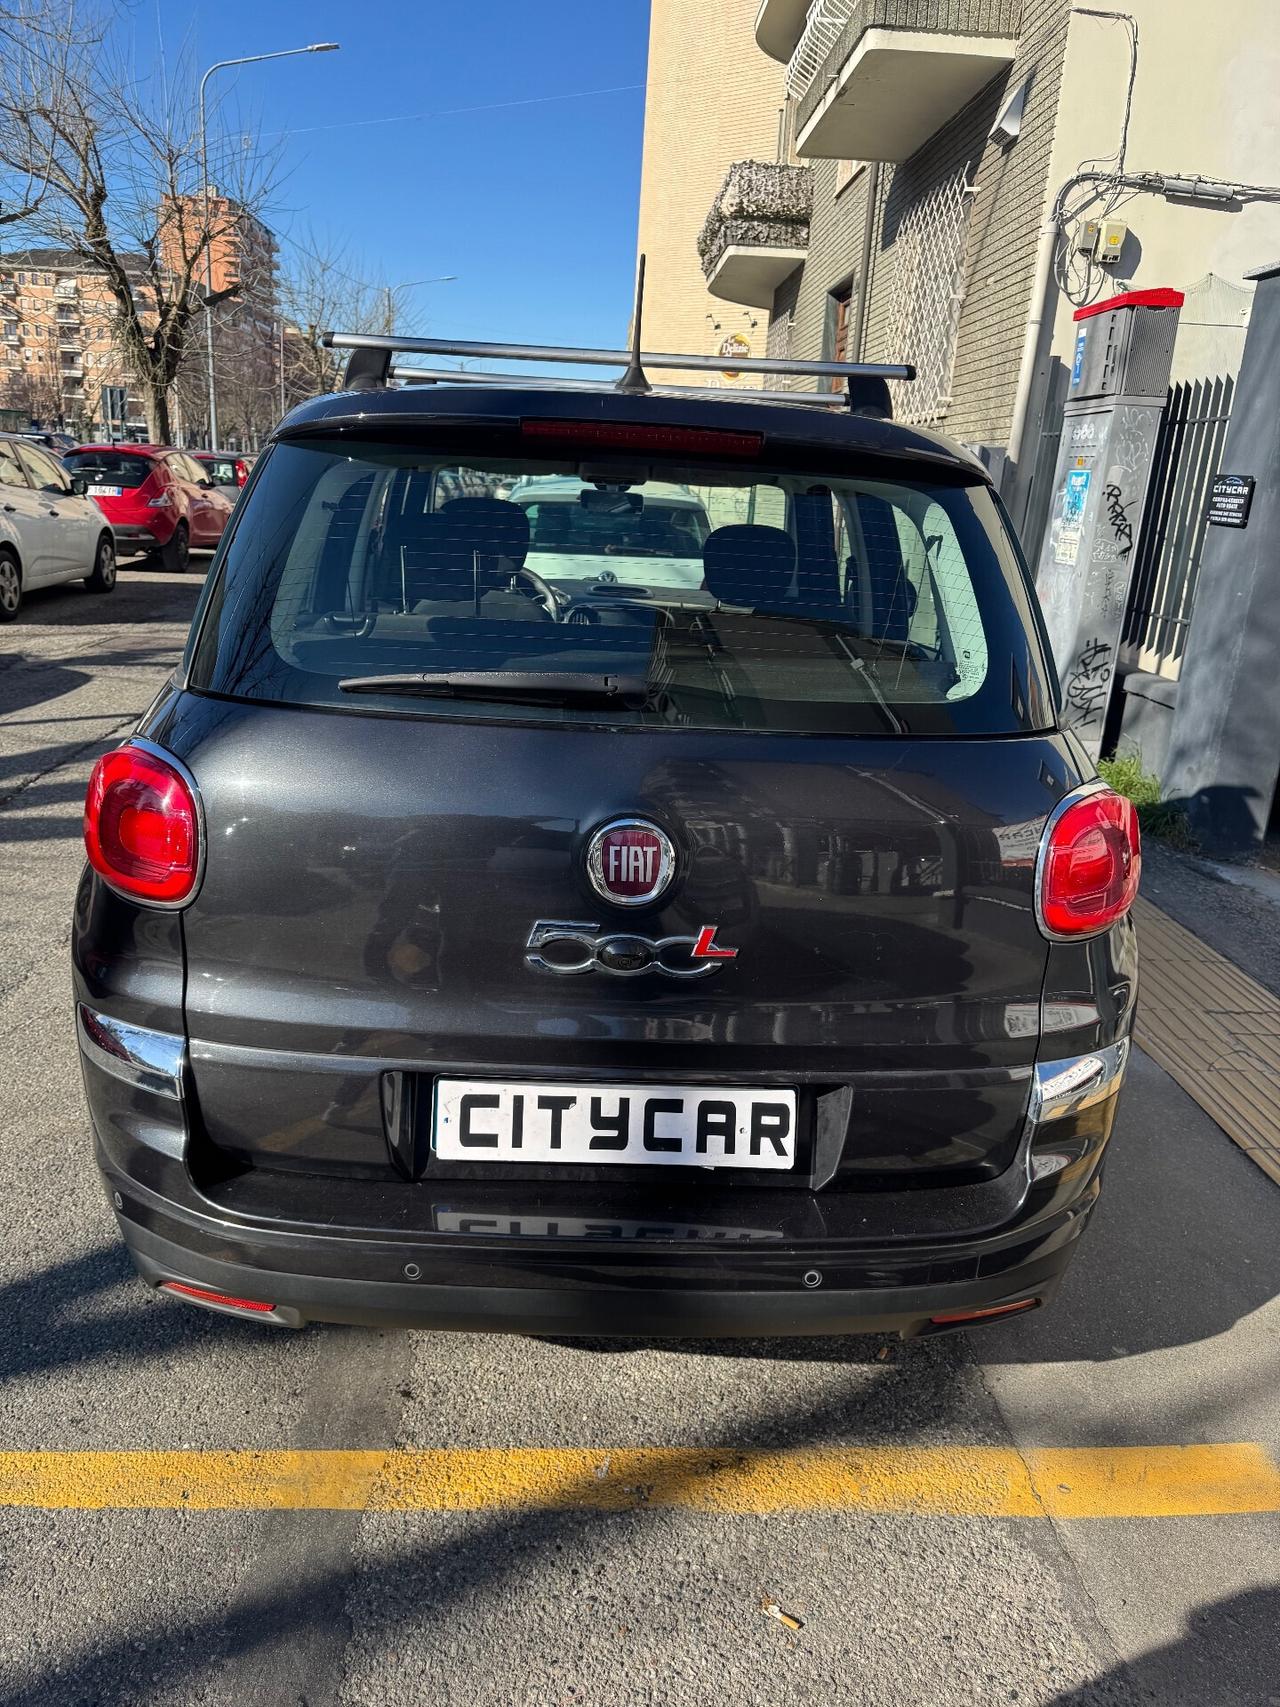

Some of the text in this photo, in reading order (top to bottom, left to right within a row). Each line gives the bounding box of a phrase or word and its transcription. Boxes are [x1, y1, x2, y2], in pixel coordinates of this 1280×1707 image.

[1213, 485, 1249, 495] CITYCAR
[609, 845, 659, 883] FIAT
[525, 919, 741, 978] 500L
[459, 1094, 792, 1157] CITYCAR
